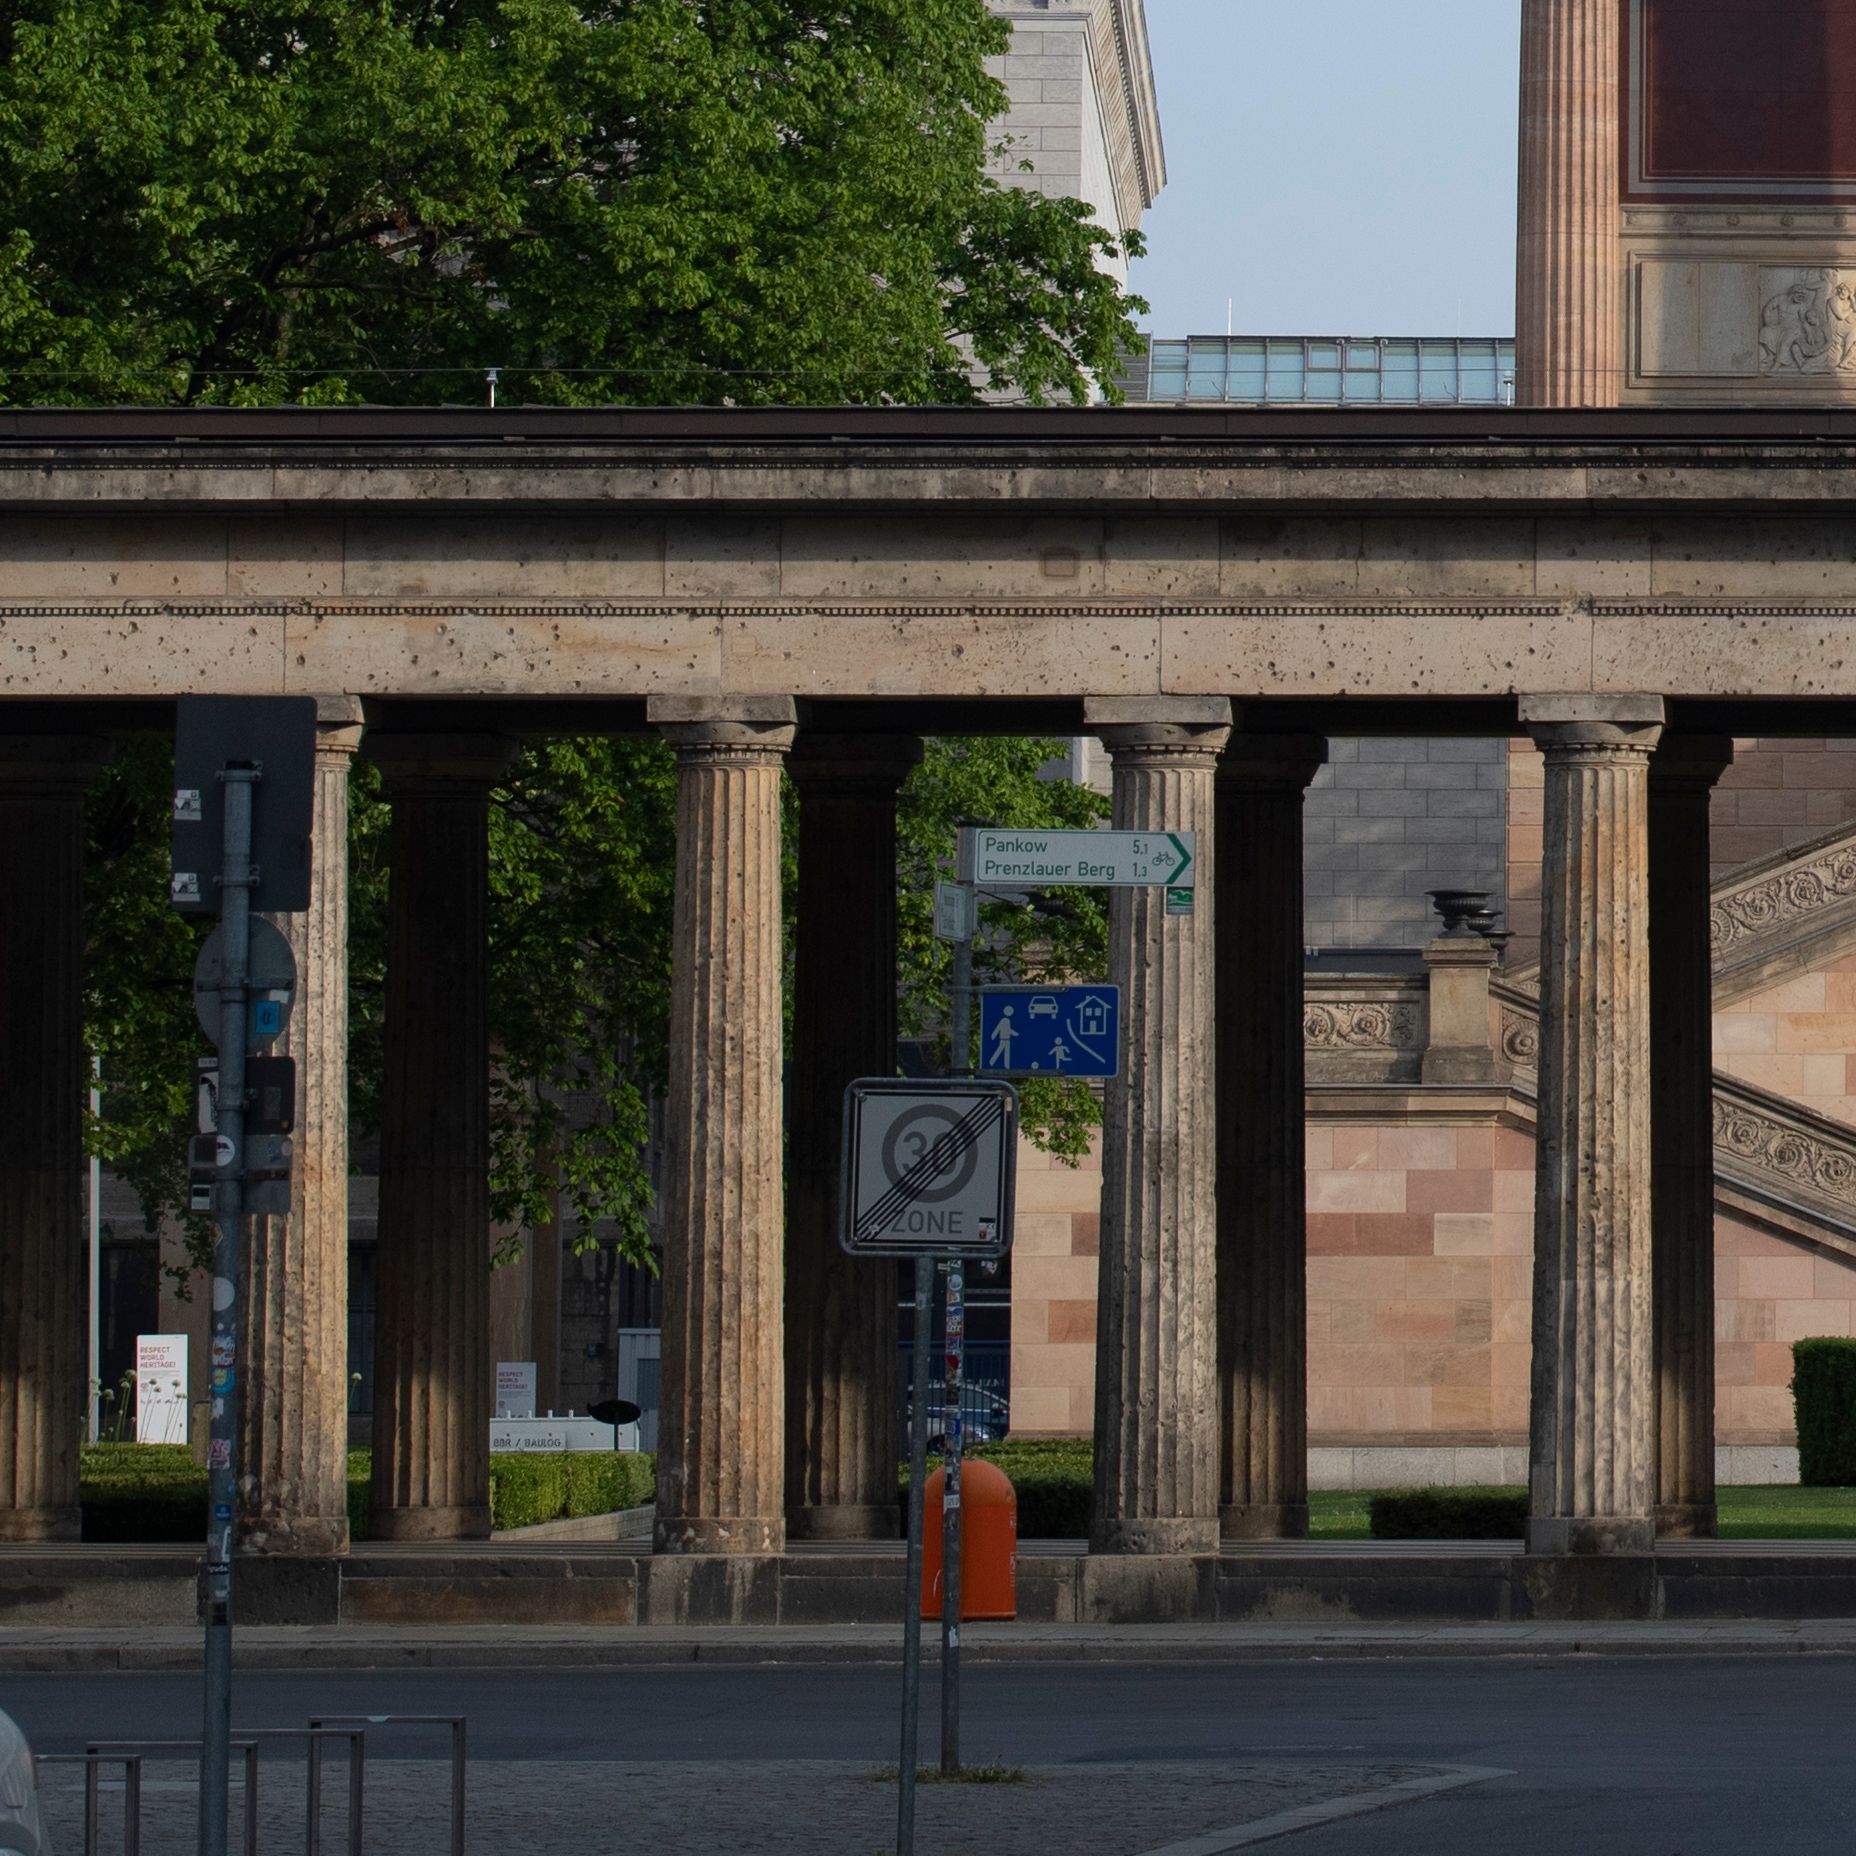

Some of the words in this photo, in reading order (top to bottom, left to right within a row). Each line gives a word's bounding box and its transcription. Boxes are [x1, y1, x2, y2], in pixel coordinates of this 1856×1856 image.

[985, 837, 1048, 853] Pankow
[1132, 839, 1148, 856] 5,1
[985, 860, 1072, 877] Prenzlauer
[1078, 861, 1115, 881] Berg
[1132, 862, 1148, 878] 1,3
[891, 1210, 963, 1234] ZONE
